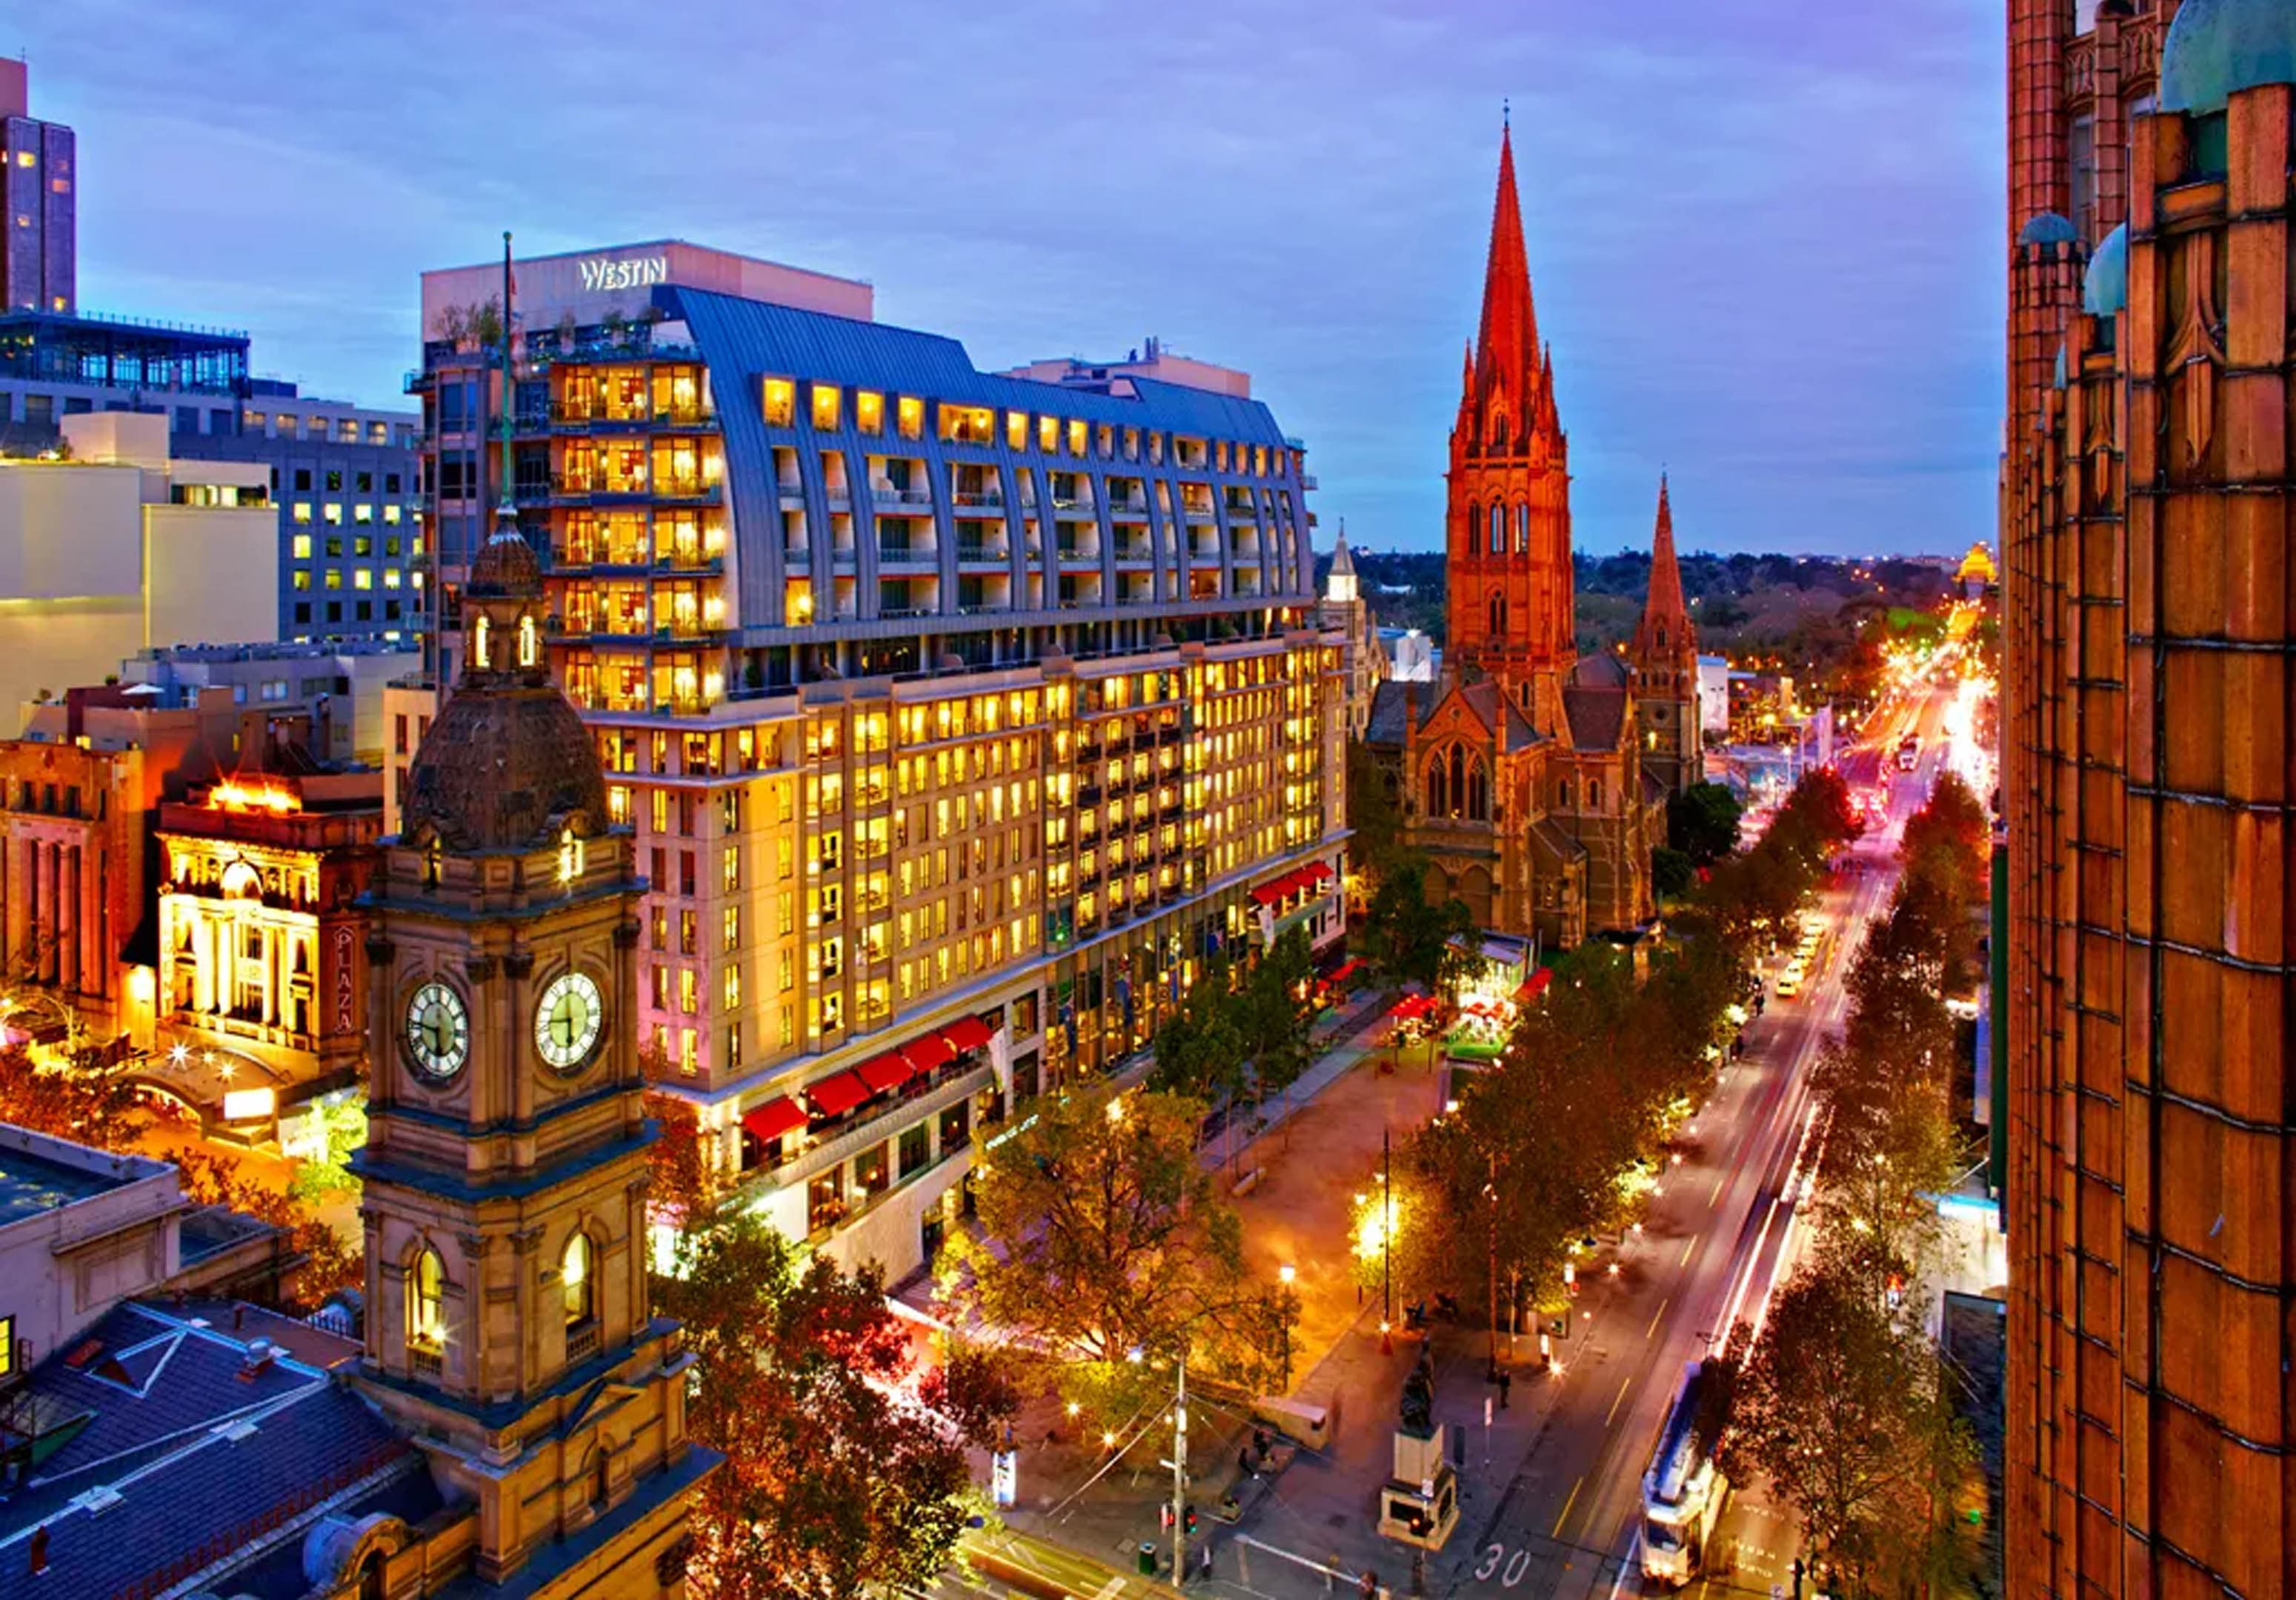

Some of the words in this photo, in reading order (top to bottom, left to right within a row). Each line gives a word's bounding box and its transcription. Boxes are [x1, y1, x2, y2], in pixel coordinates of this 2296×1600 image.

[579, 258, 666, 290] WESTIN
[338, 933, 352, 1029] PLAZA
[1475, 1543, 1531, 1587] 30
